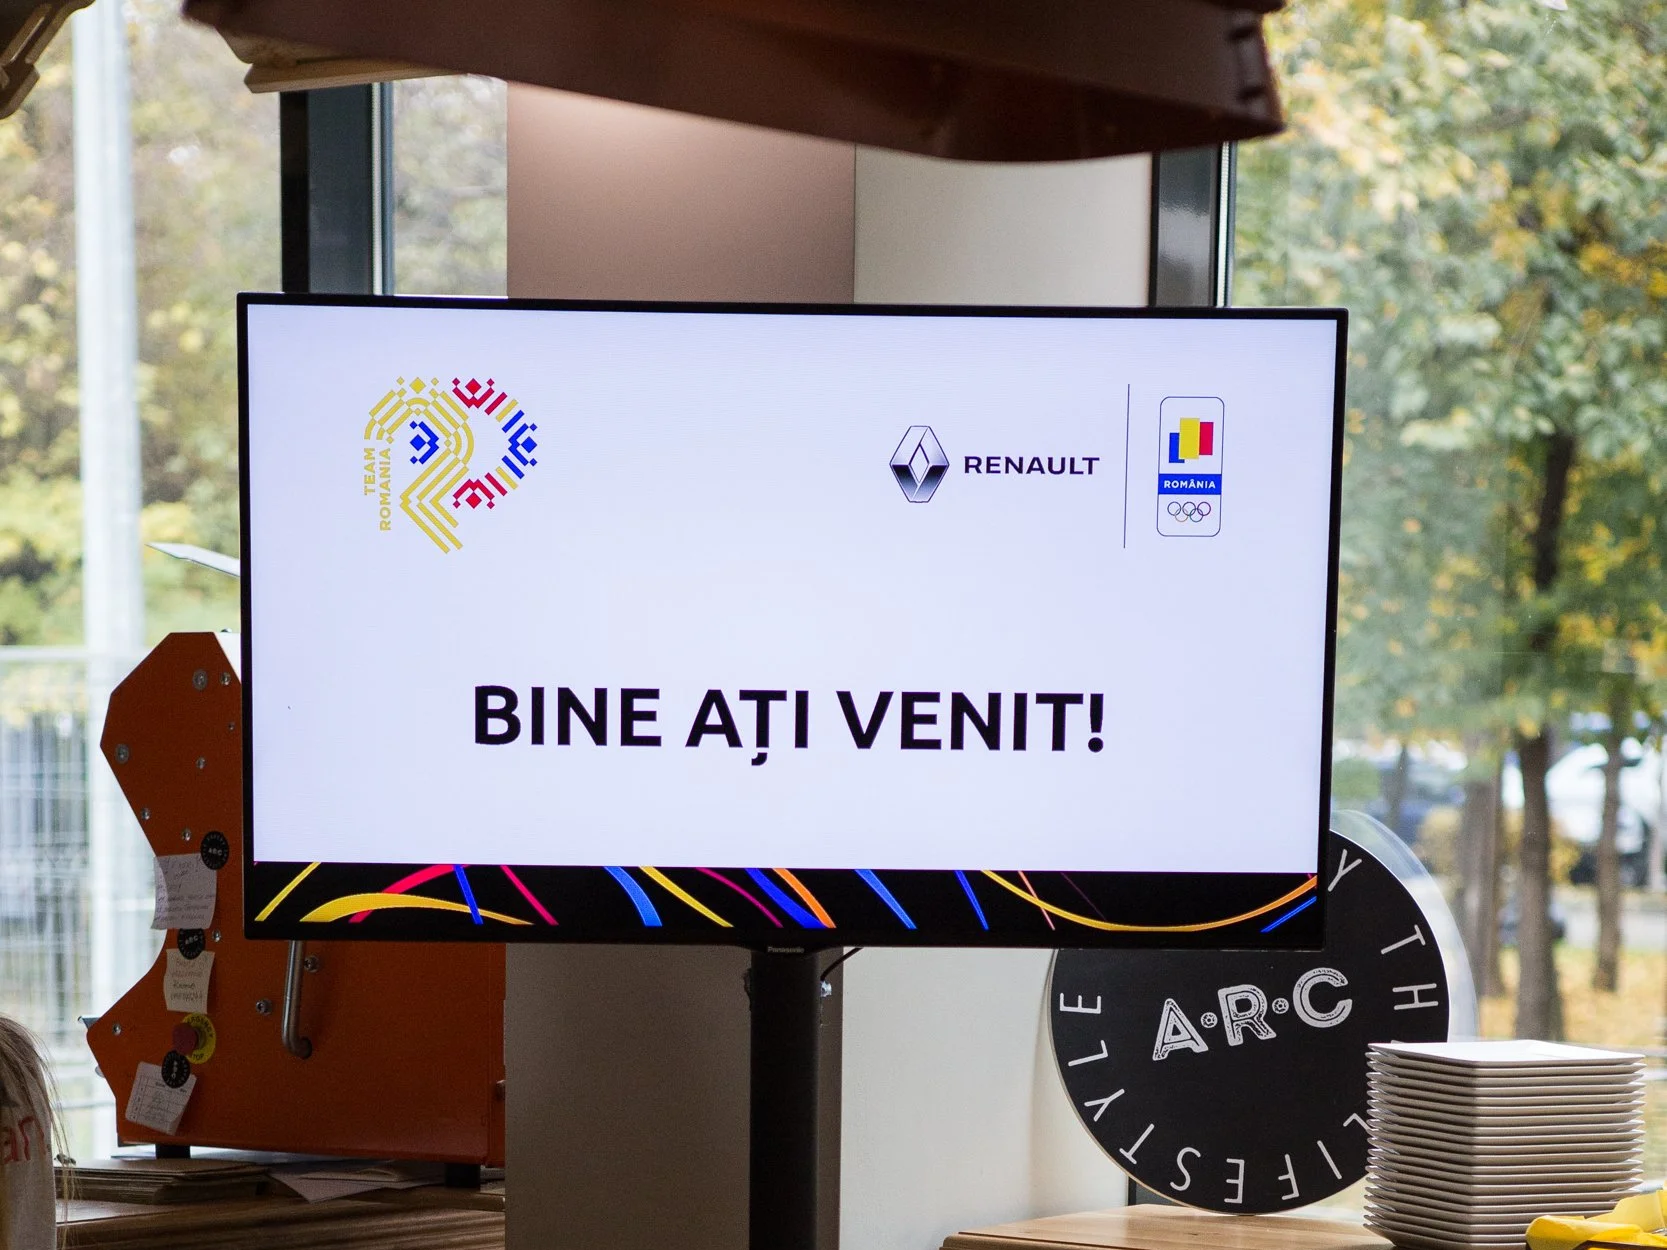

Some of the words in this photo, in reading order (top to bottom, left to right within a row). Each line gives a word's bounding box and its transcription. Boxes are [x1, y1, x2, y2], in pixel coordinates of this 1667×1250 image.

[363, 447, 376, 496] TEAM
[379, 447, 392, 532] ROMANIA
[963, 455, 1101, 475] RENAULT
[1162, 478, 1217, 490] ROMÂNIA
[474, 684, 662, 747] BINE
[685, 687, 809, 767] AȚI
[836, 690, 1105, 754] VENIT!
[1380, 923, 1439, 1043] TH
